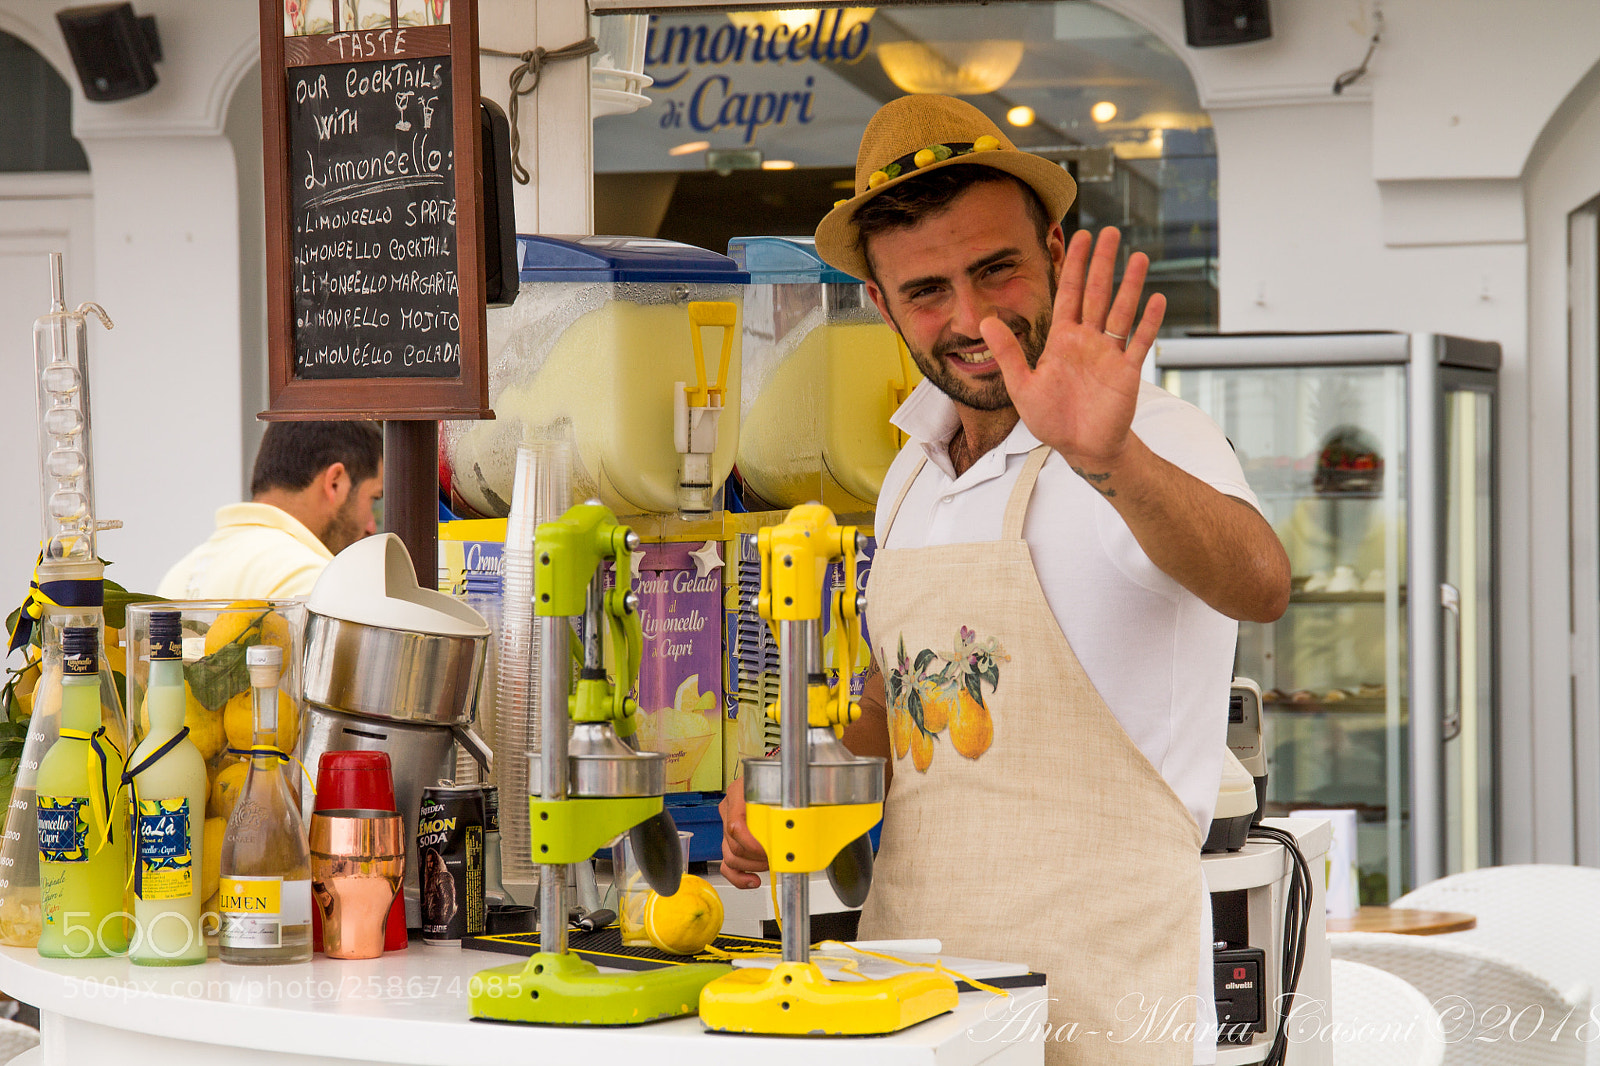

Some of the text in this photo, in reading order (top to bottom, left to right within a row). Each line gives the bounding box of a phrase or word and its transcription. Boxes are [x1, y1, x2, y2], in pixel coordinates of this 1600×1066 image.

[327, 29, 407, 59] TASTE
[644, 8, 870, 80] imoncello
[296, 74, 330, 103] OUR
[660, 74, 816, 146] di Capri
[305, 206, 393, 233] LIMONCELLO
[299, 240, 381, 266] LIMONCELLO
[390, 269, 459, 297] MARGARITA
[401, 304, 460, 333] MOJITO
[304, 342, 393, 368] LIMONCELLO
[672, 571, 719, 594] Gelato
[668, 599, 677, 613] al
[660, 638, 694, 662] Capri
[140, 816, 176, 836] ioLà
[420, 831, 448, 848] SODA
[220, 894, 267, 910] LIMEN
[1225, 981, 1253, 990] olivetti
